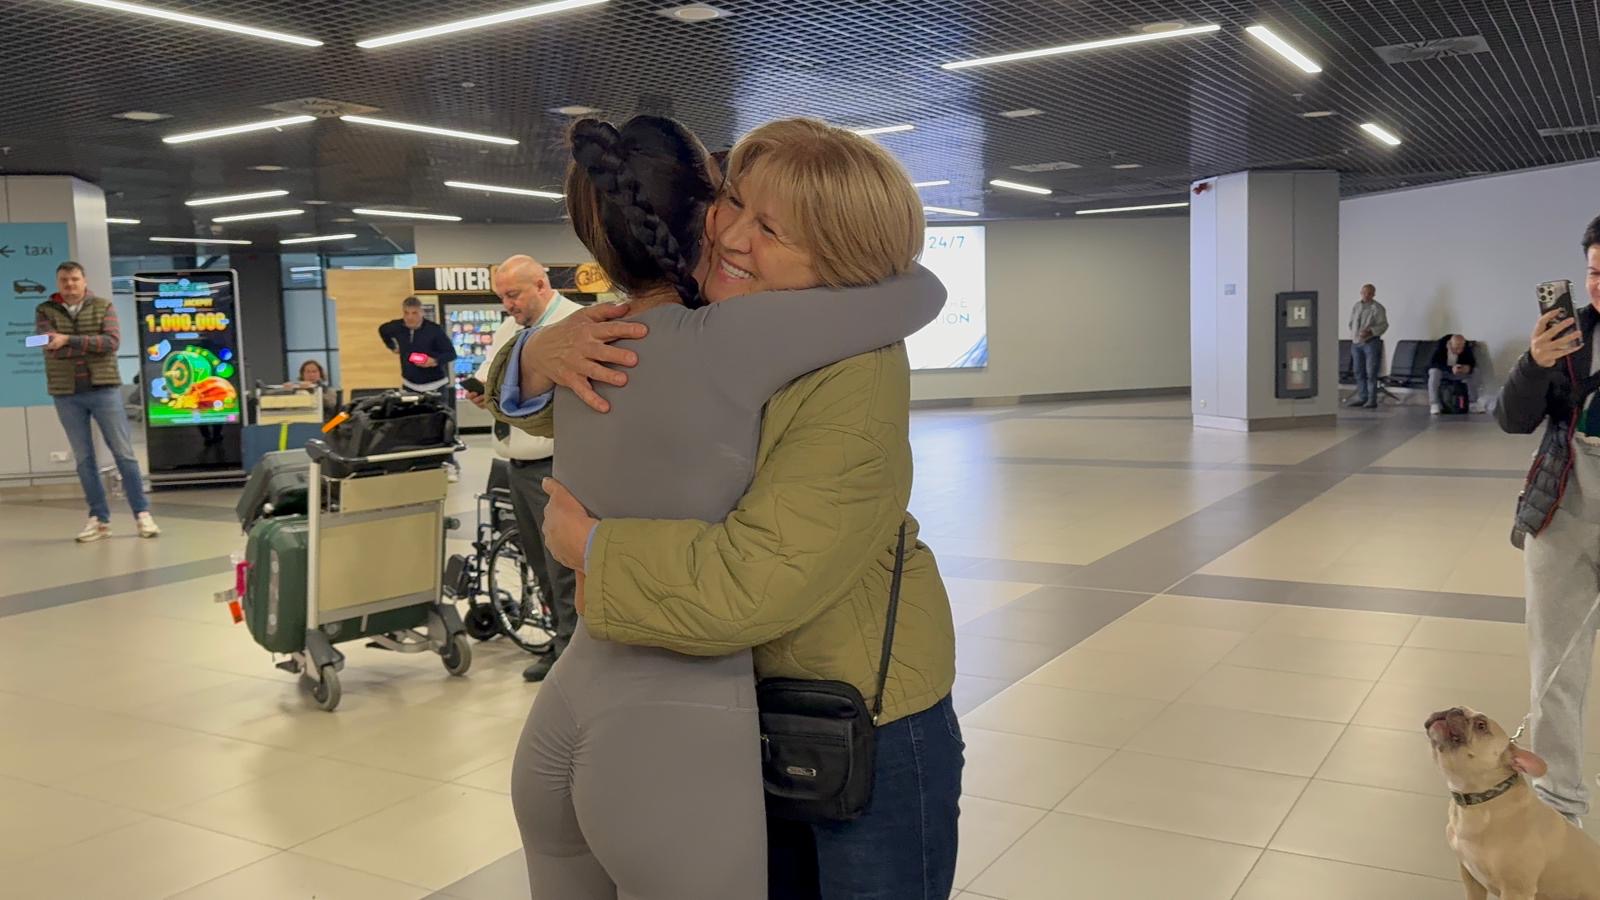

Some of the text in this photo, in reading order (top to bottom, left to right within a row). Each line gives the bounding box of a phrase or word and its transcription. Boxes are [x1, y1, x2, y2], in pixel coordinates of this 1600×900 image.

[928, 235, 966, 249] 24/7
[24, 243, 53, 256] taxi
[434, 267, 490, 290] INTER
[1294, 306, 1306, 320] H
